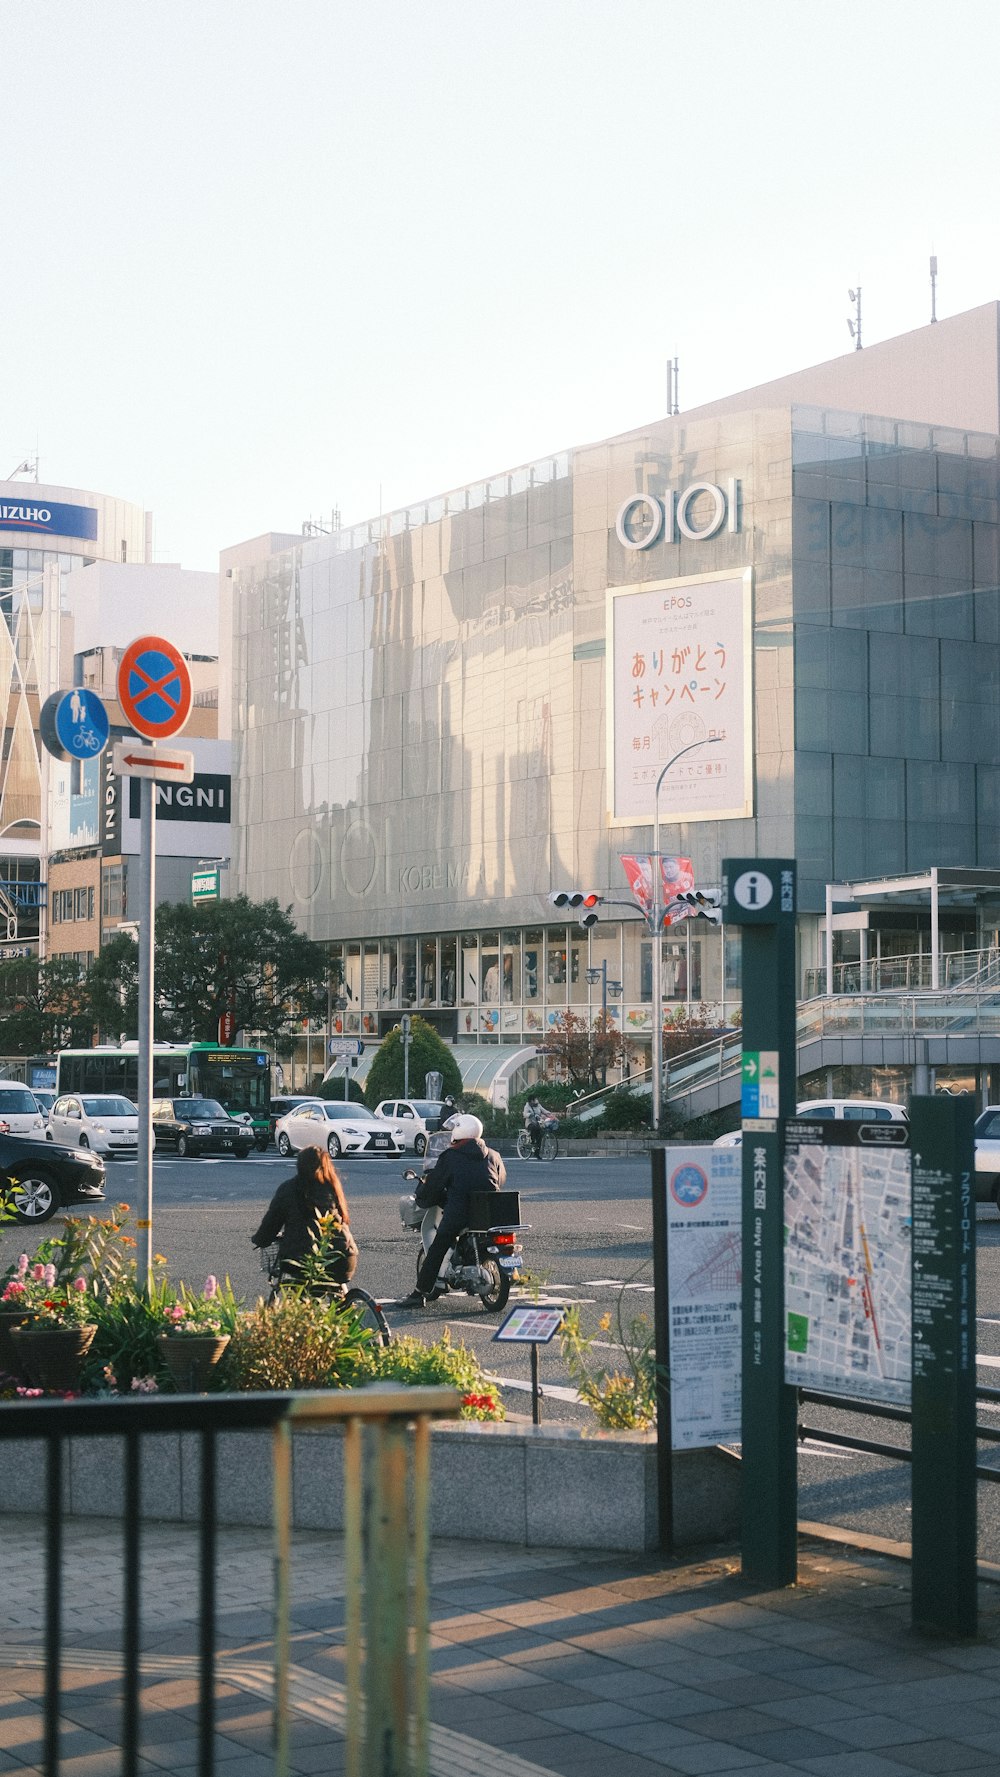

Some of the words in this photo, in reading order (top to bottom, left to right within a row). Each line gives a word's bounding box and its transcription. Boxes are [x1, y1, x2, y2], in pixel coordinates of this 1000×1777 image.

[663, 596, 692, 611] EPOS
[632, 641, 727, 678] ありがとう
[632, 678, 727, 709] キャンペーン
[156, 786, 225, 808] NGNI
[398, 864, 443, 893] KOBE
[781, 870, 794, 913] 案内図
[753, 1147, 767, 1210] 案内図
[961, 1171, 971, 1254] フラワーロード
[754, 1217, 763, 1244] Map
[754, 1250, 763, 1284] Area
